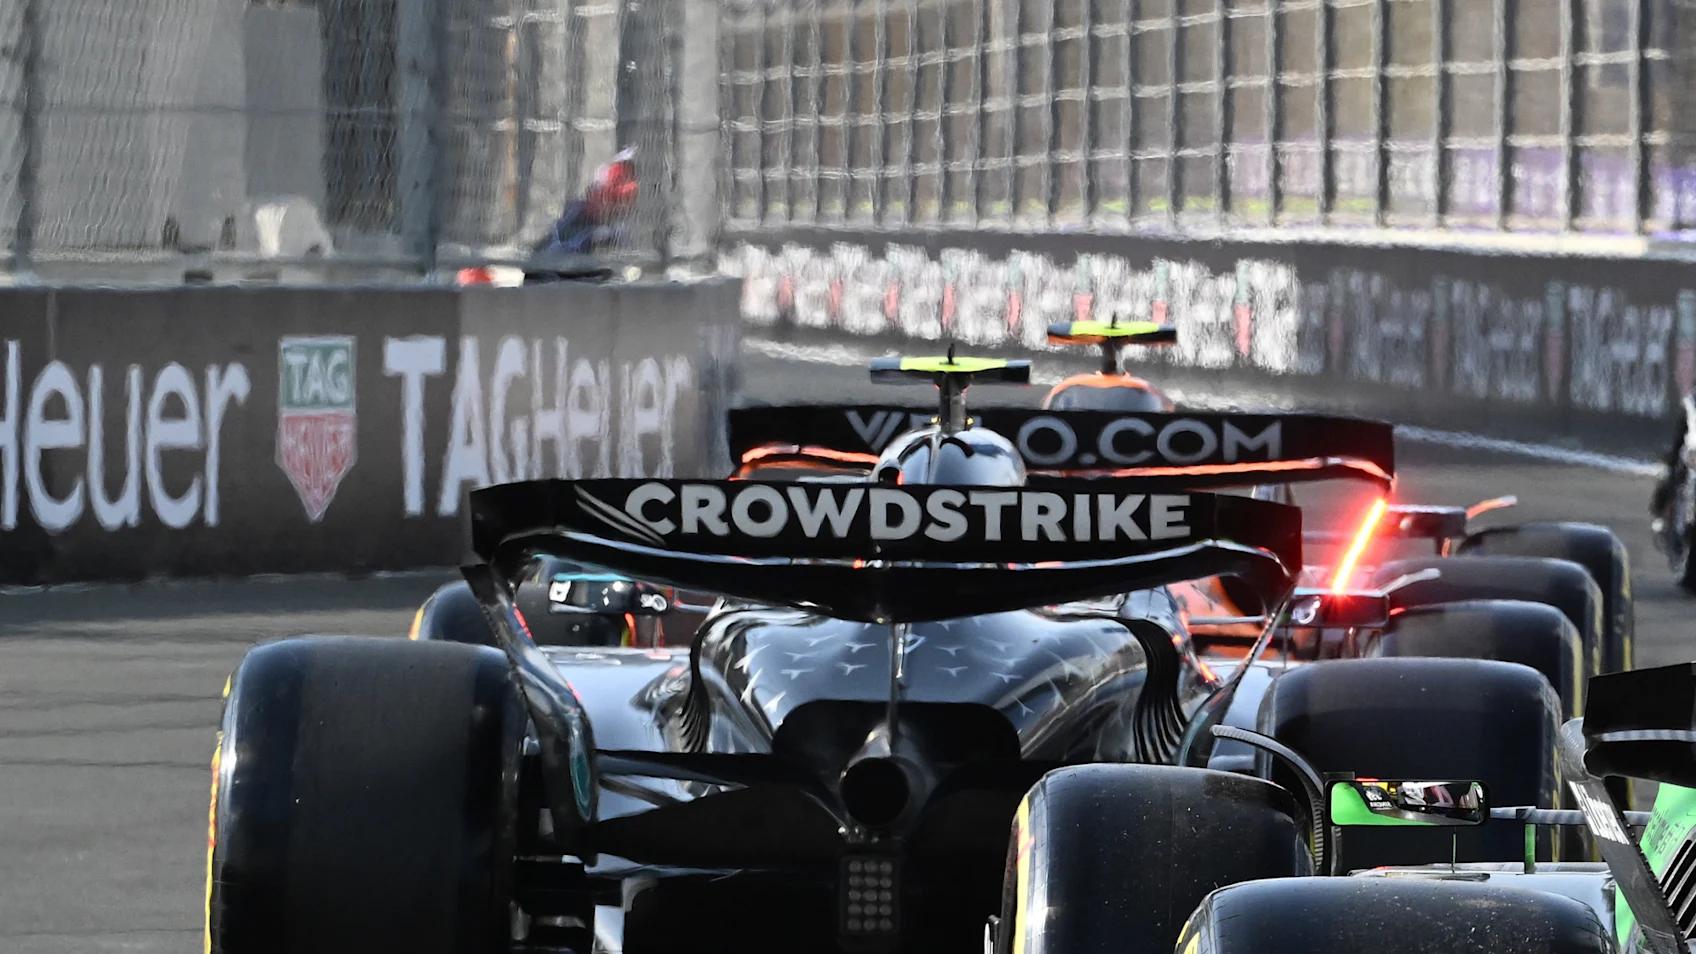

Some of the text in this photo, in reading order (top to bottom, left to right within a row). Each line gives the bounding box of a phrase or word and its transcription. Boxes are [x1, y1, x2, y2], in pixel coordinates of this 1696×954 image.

[285, 350, 349, 403] TAG
[846, 410, 1282, 465] VO.COM
[624, 482, 1191, 542] CROWDSTRIKE
